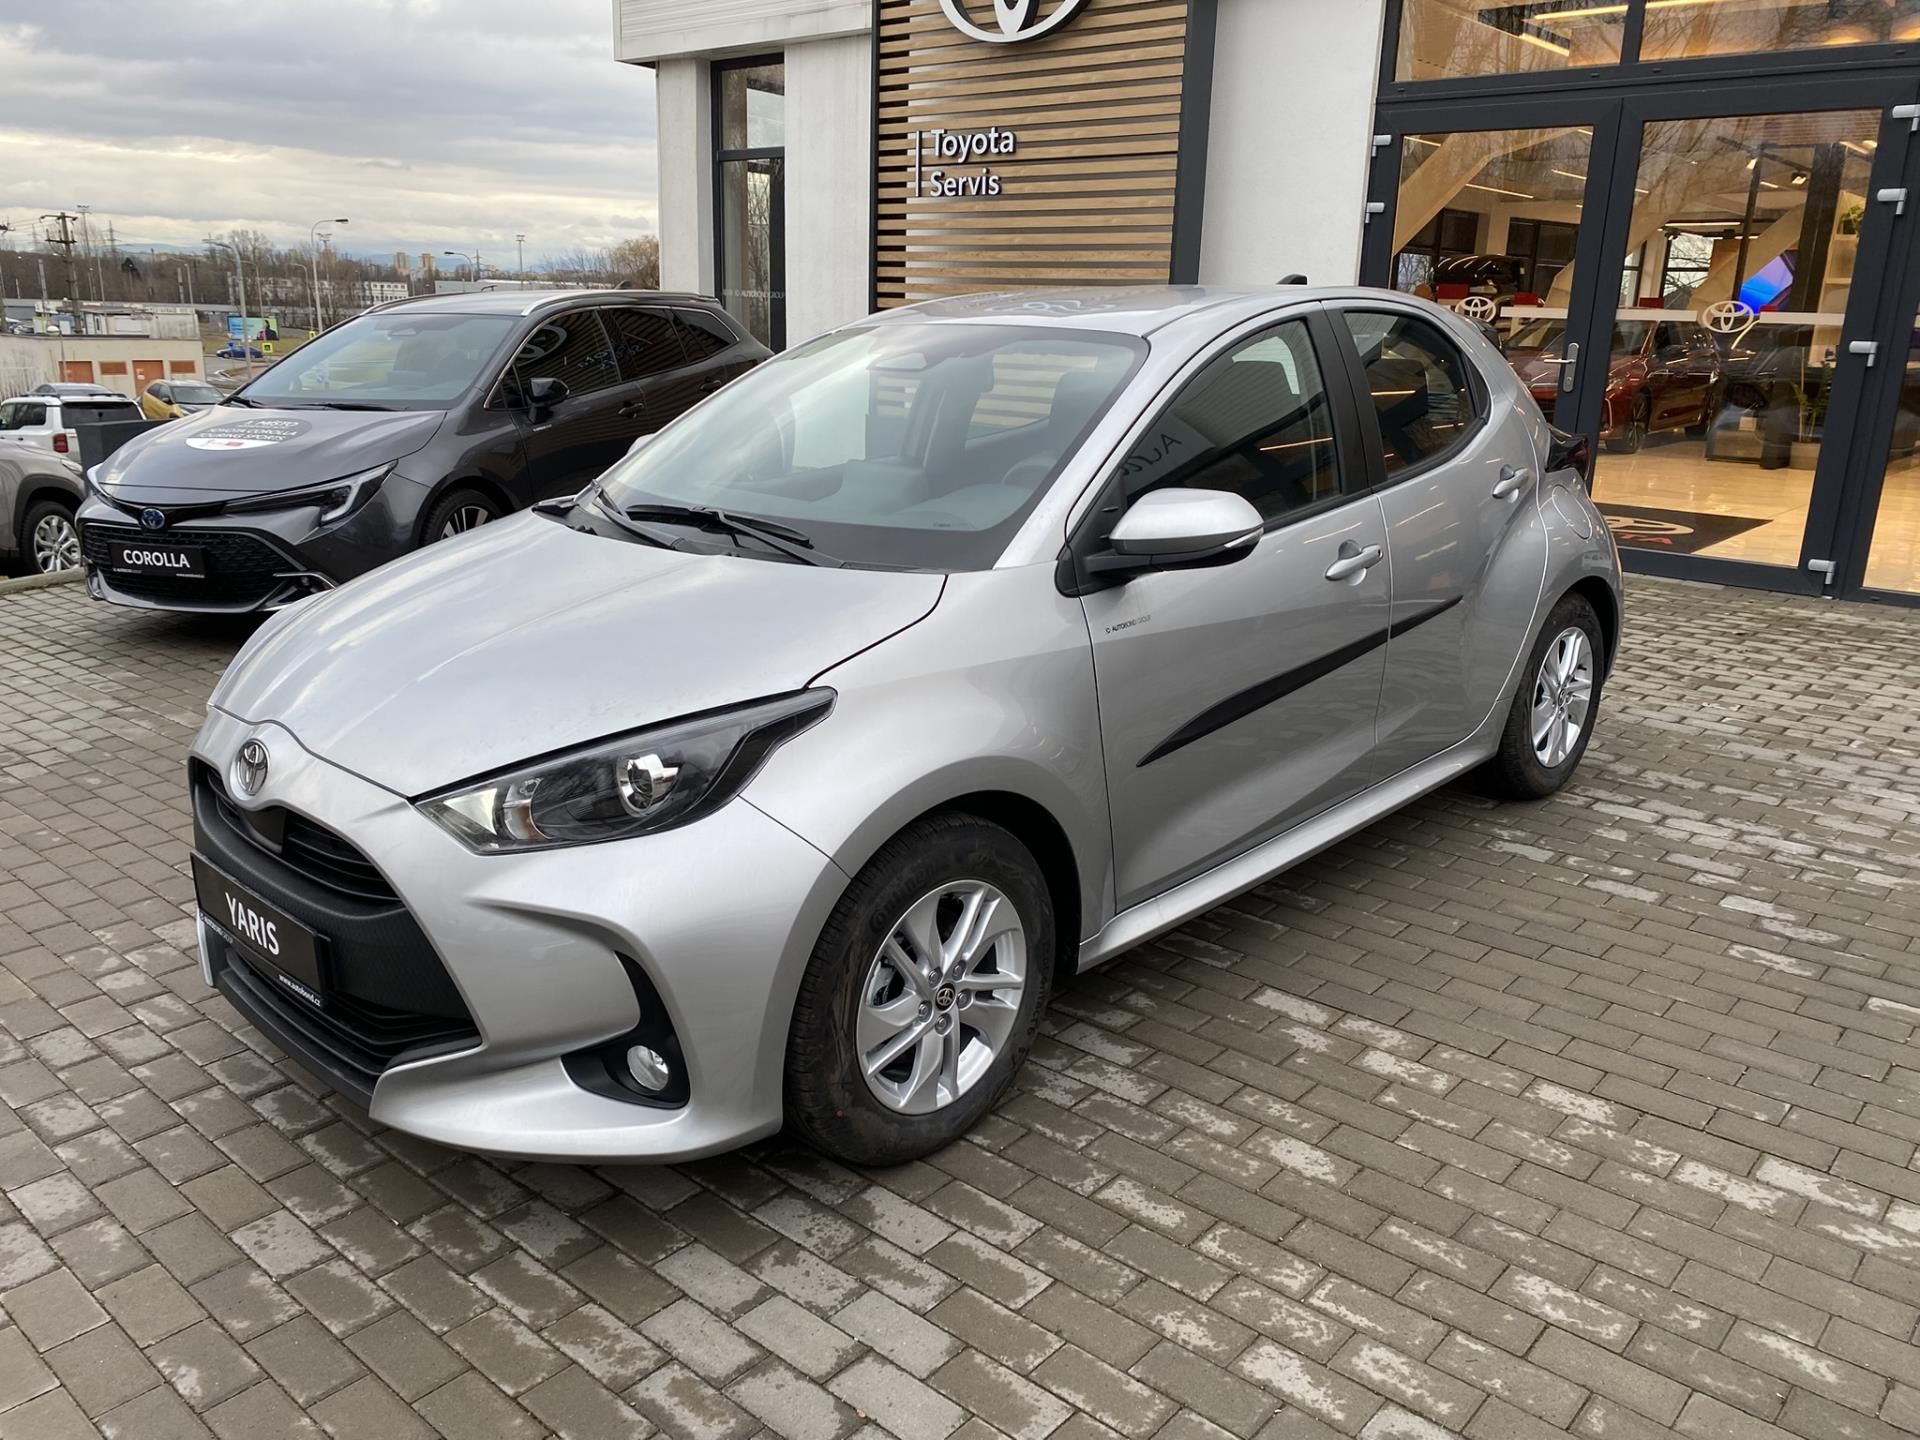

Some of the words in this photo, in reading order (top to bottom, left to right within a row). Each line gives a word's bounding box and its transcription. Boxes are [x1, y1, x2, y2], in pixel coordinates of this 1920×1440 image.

[930, 126, 1015, 163] Toyota
[930, 167, 1001, 197] Servis
[122, 549, 191, 569] COROLLA
[225, 892, 279, 955] YARIS
